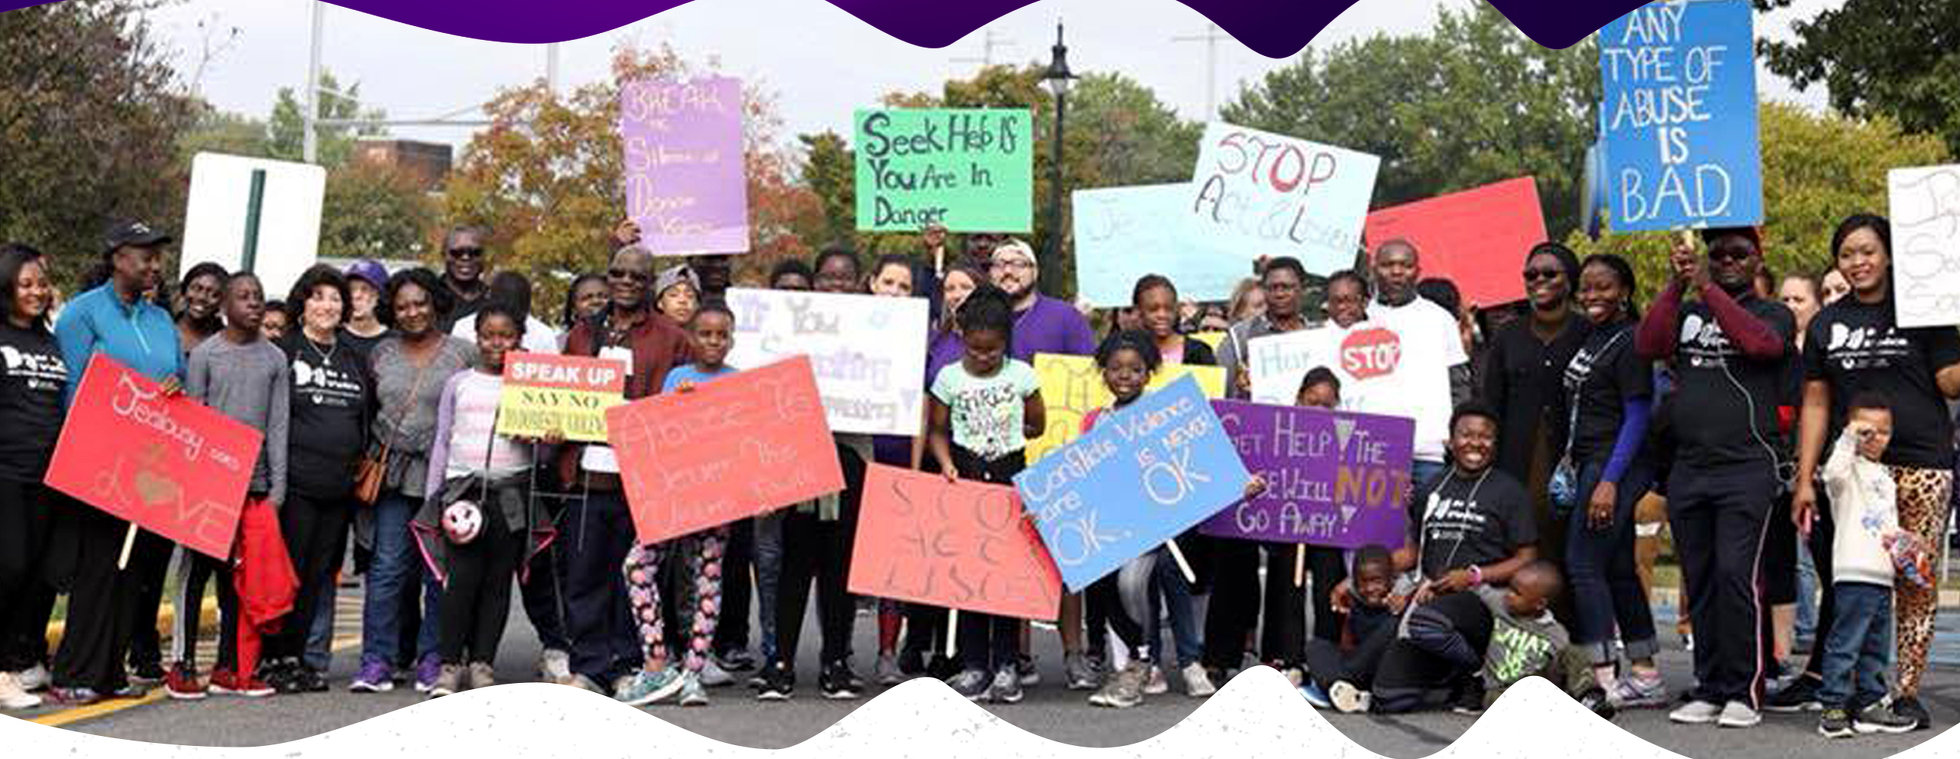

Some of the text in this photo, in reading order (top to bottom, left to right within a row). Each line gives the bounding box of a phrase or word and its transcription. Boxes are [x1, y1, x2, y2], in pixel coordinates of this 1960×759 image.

[1622, 2, 1688, 45] ANY
[1604, 45, 1728, 83] TYPE OF
[1611, 85, 1711, 131] ABUSE
[863, 111, 944, 157] Seek
[1658, 126, 1689, 165] IS
[866, 157, 993, 191] You Are In
[1217, 131, 1338, 196] STOP
[873, 196, 948, 227] Danger
[511, 362, 617, 387] SPEAK UP
[1354, 429, 1387, 464] THE
[1142, 442, 1213, 505] OK
[1281, 466, 1333, 503] WILL
[1332, 462, 1404, 509] NOT
[1236, 501, 1271, 534] GO
